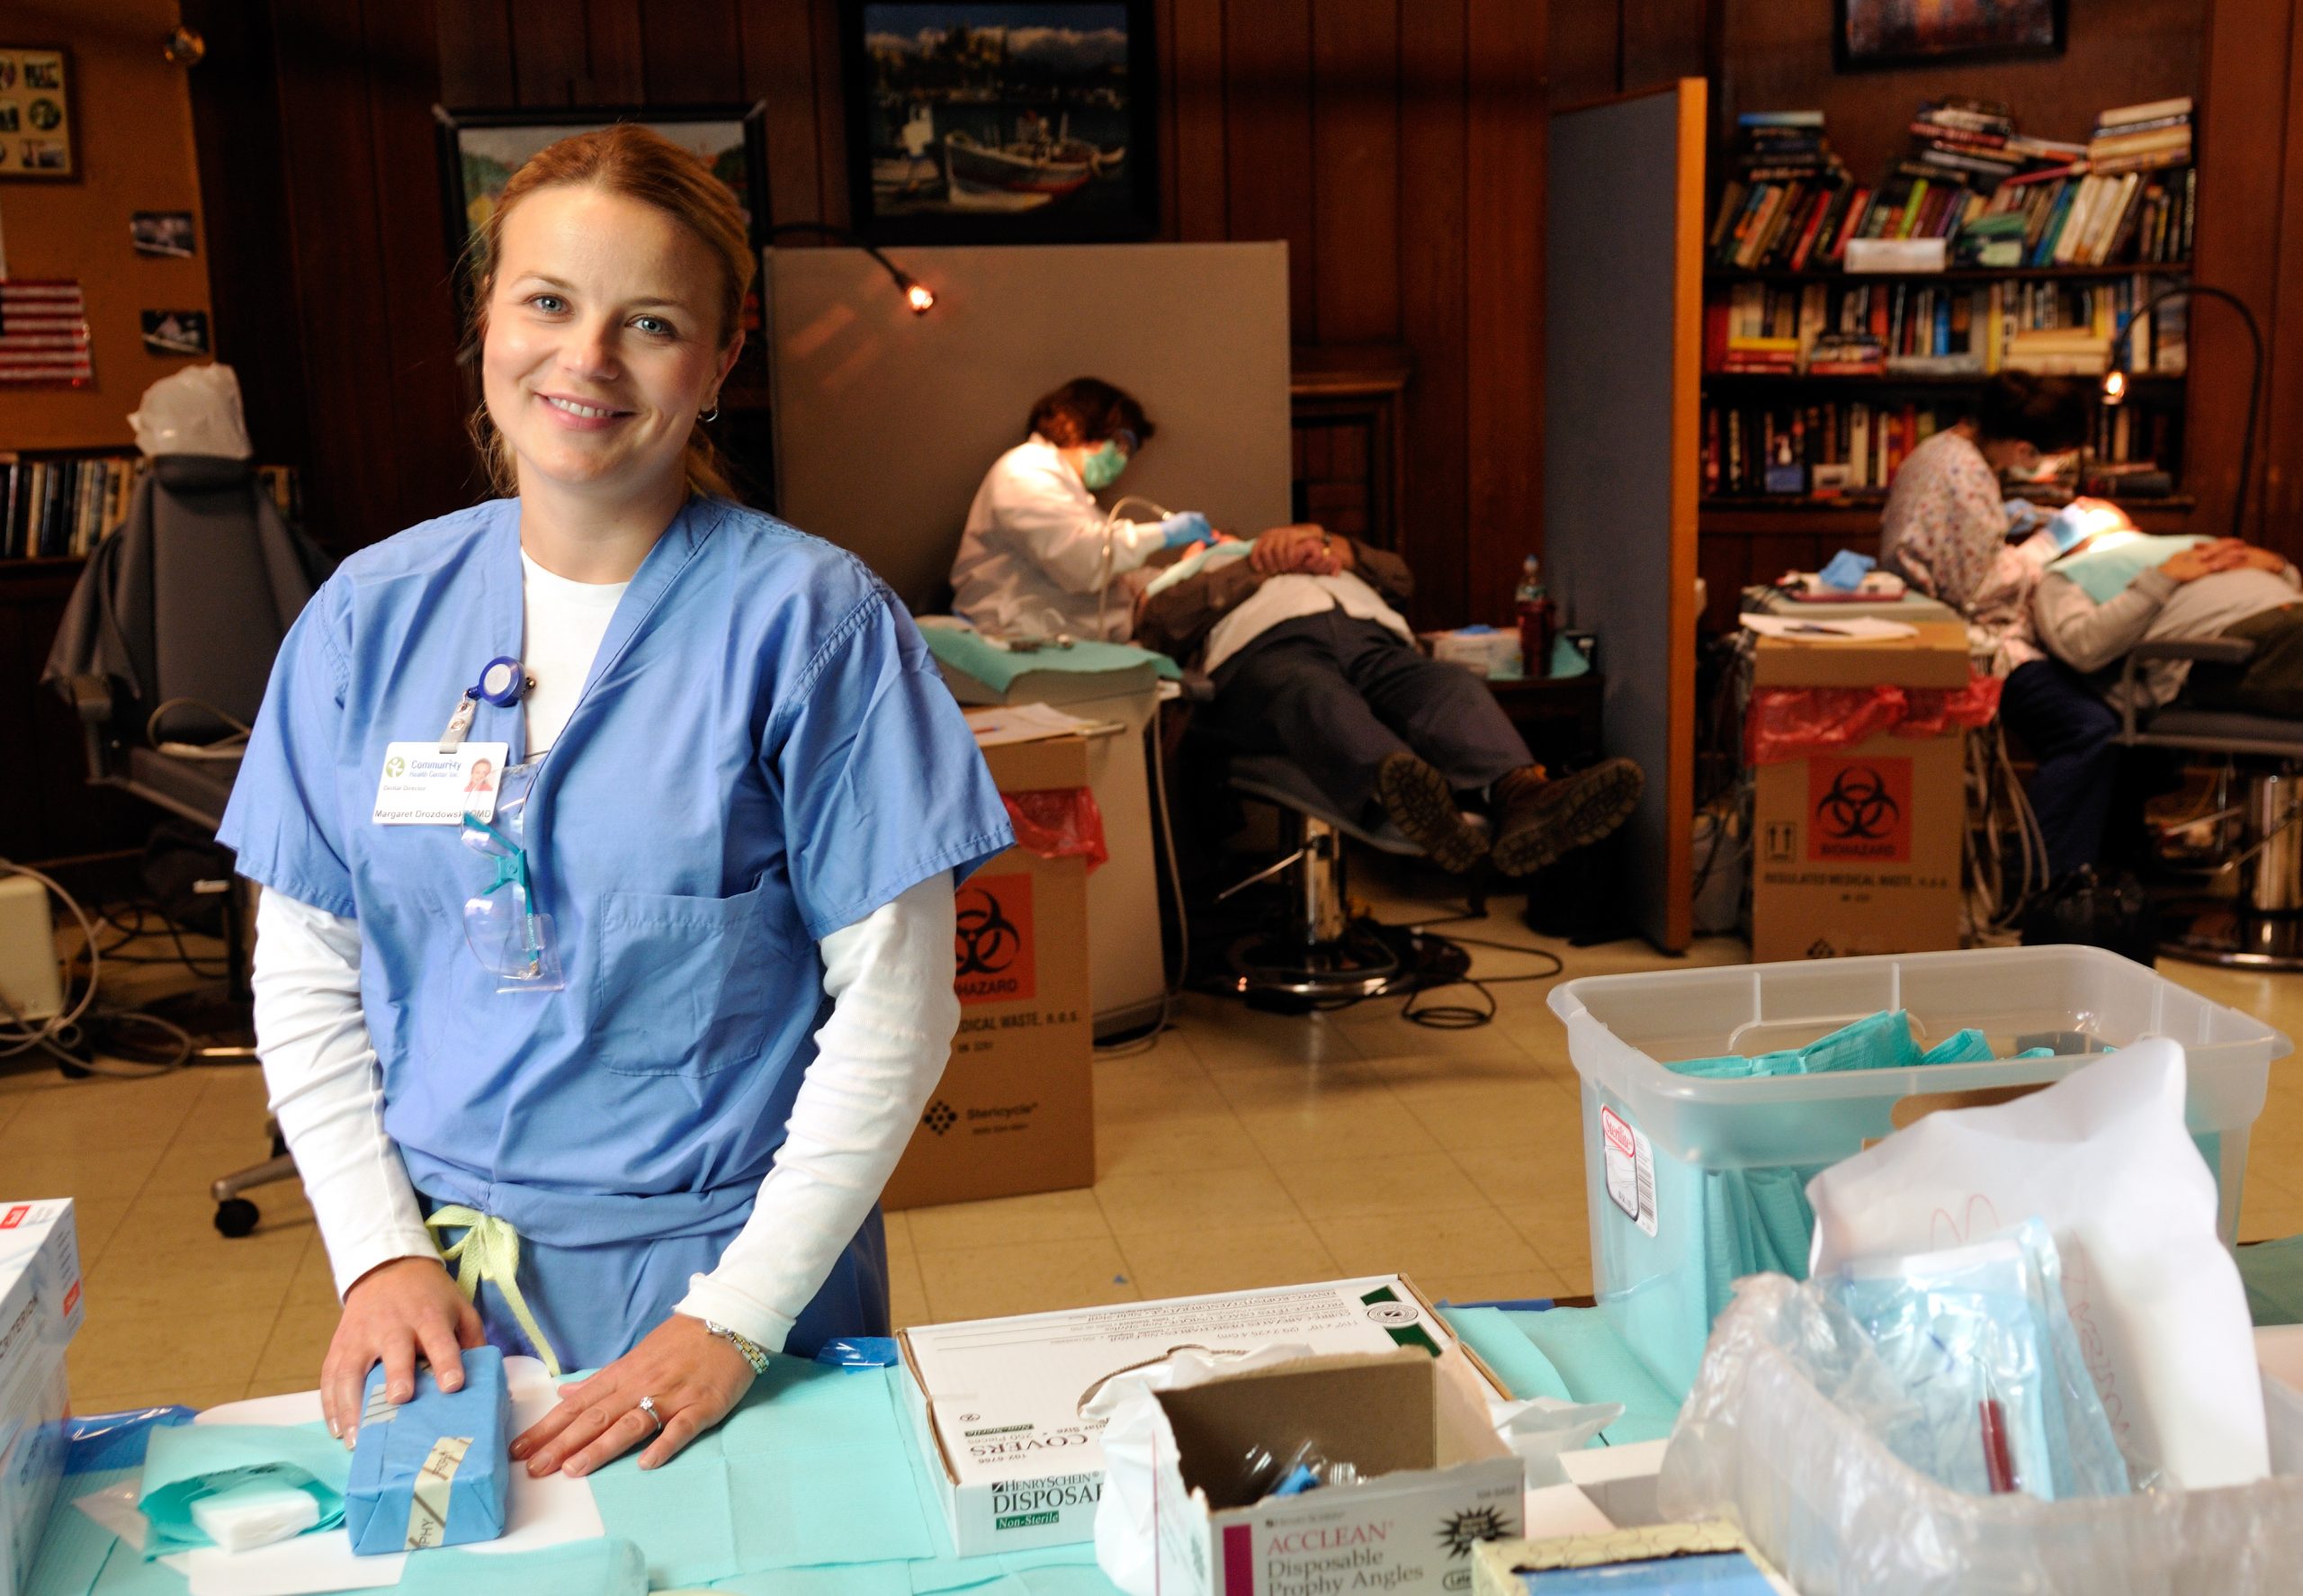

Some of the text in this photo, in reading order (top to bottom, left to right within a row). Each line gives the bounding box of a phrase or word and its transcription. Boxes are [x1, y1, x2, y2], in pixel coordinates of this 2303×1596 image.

[374, 809, 413, 820] Margaret
[415, 809, 463, 819] Drozdowsk
[970, 1433, 1089, 1457] COVERS
[999, 1511, 1059, 1529] Non-Sterile
[1268, 1548, 1384, 1579] Disposable
[1268, 1565, 1424, 1596] Prophy Angles
